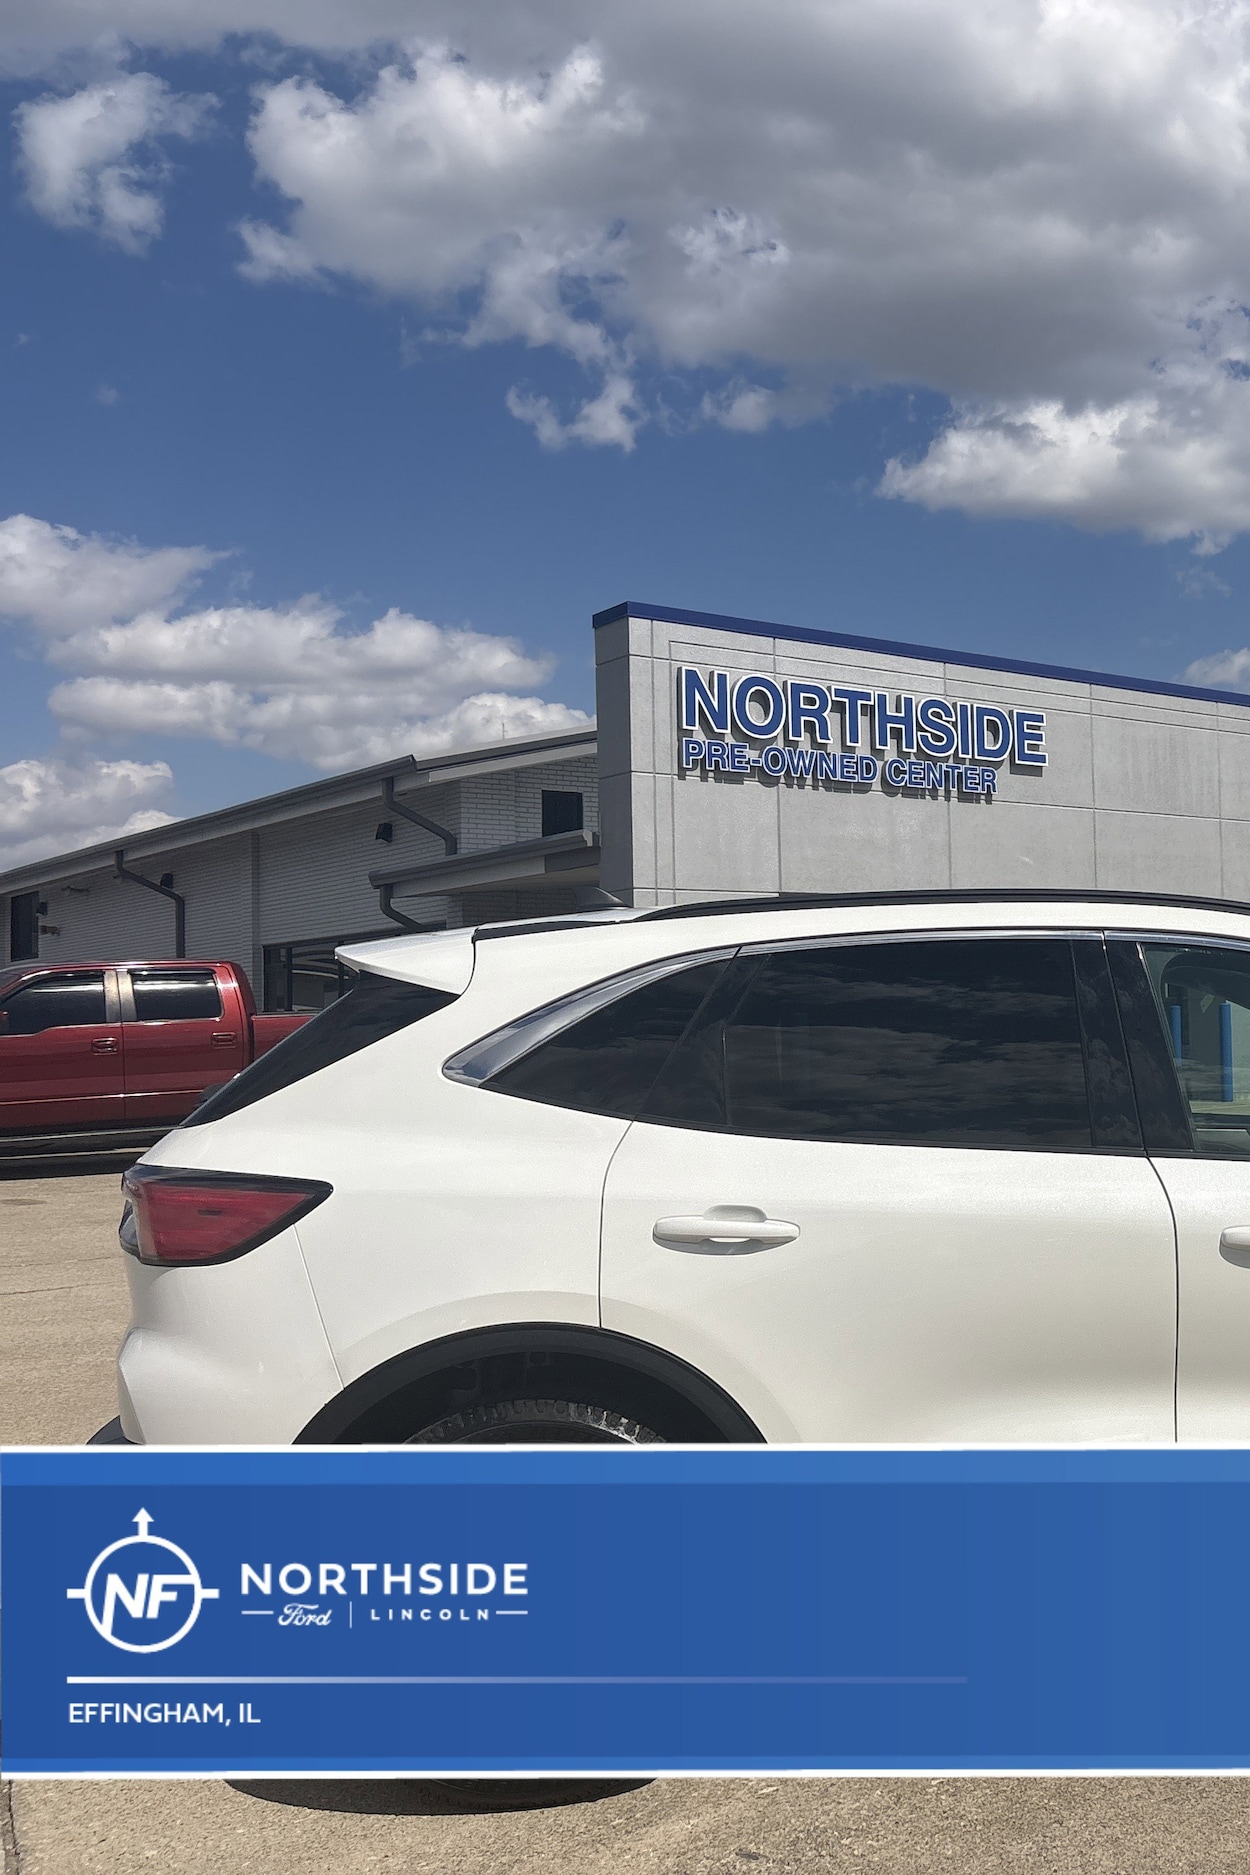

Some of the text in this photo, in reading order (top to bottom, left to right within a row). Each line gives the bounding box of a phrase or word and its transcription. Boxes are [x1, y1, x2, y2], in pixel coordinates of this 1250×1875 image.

[681, 665, 1049, 768] NORTHSIDE
[682, 737, 999, 795] PRE-OWNED CENTER
